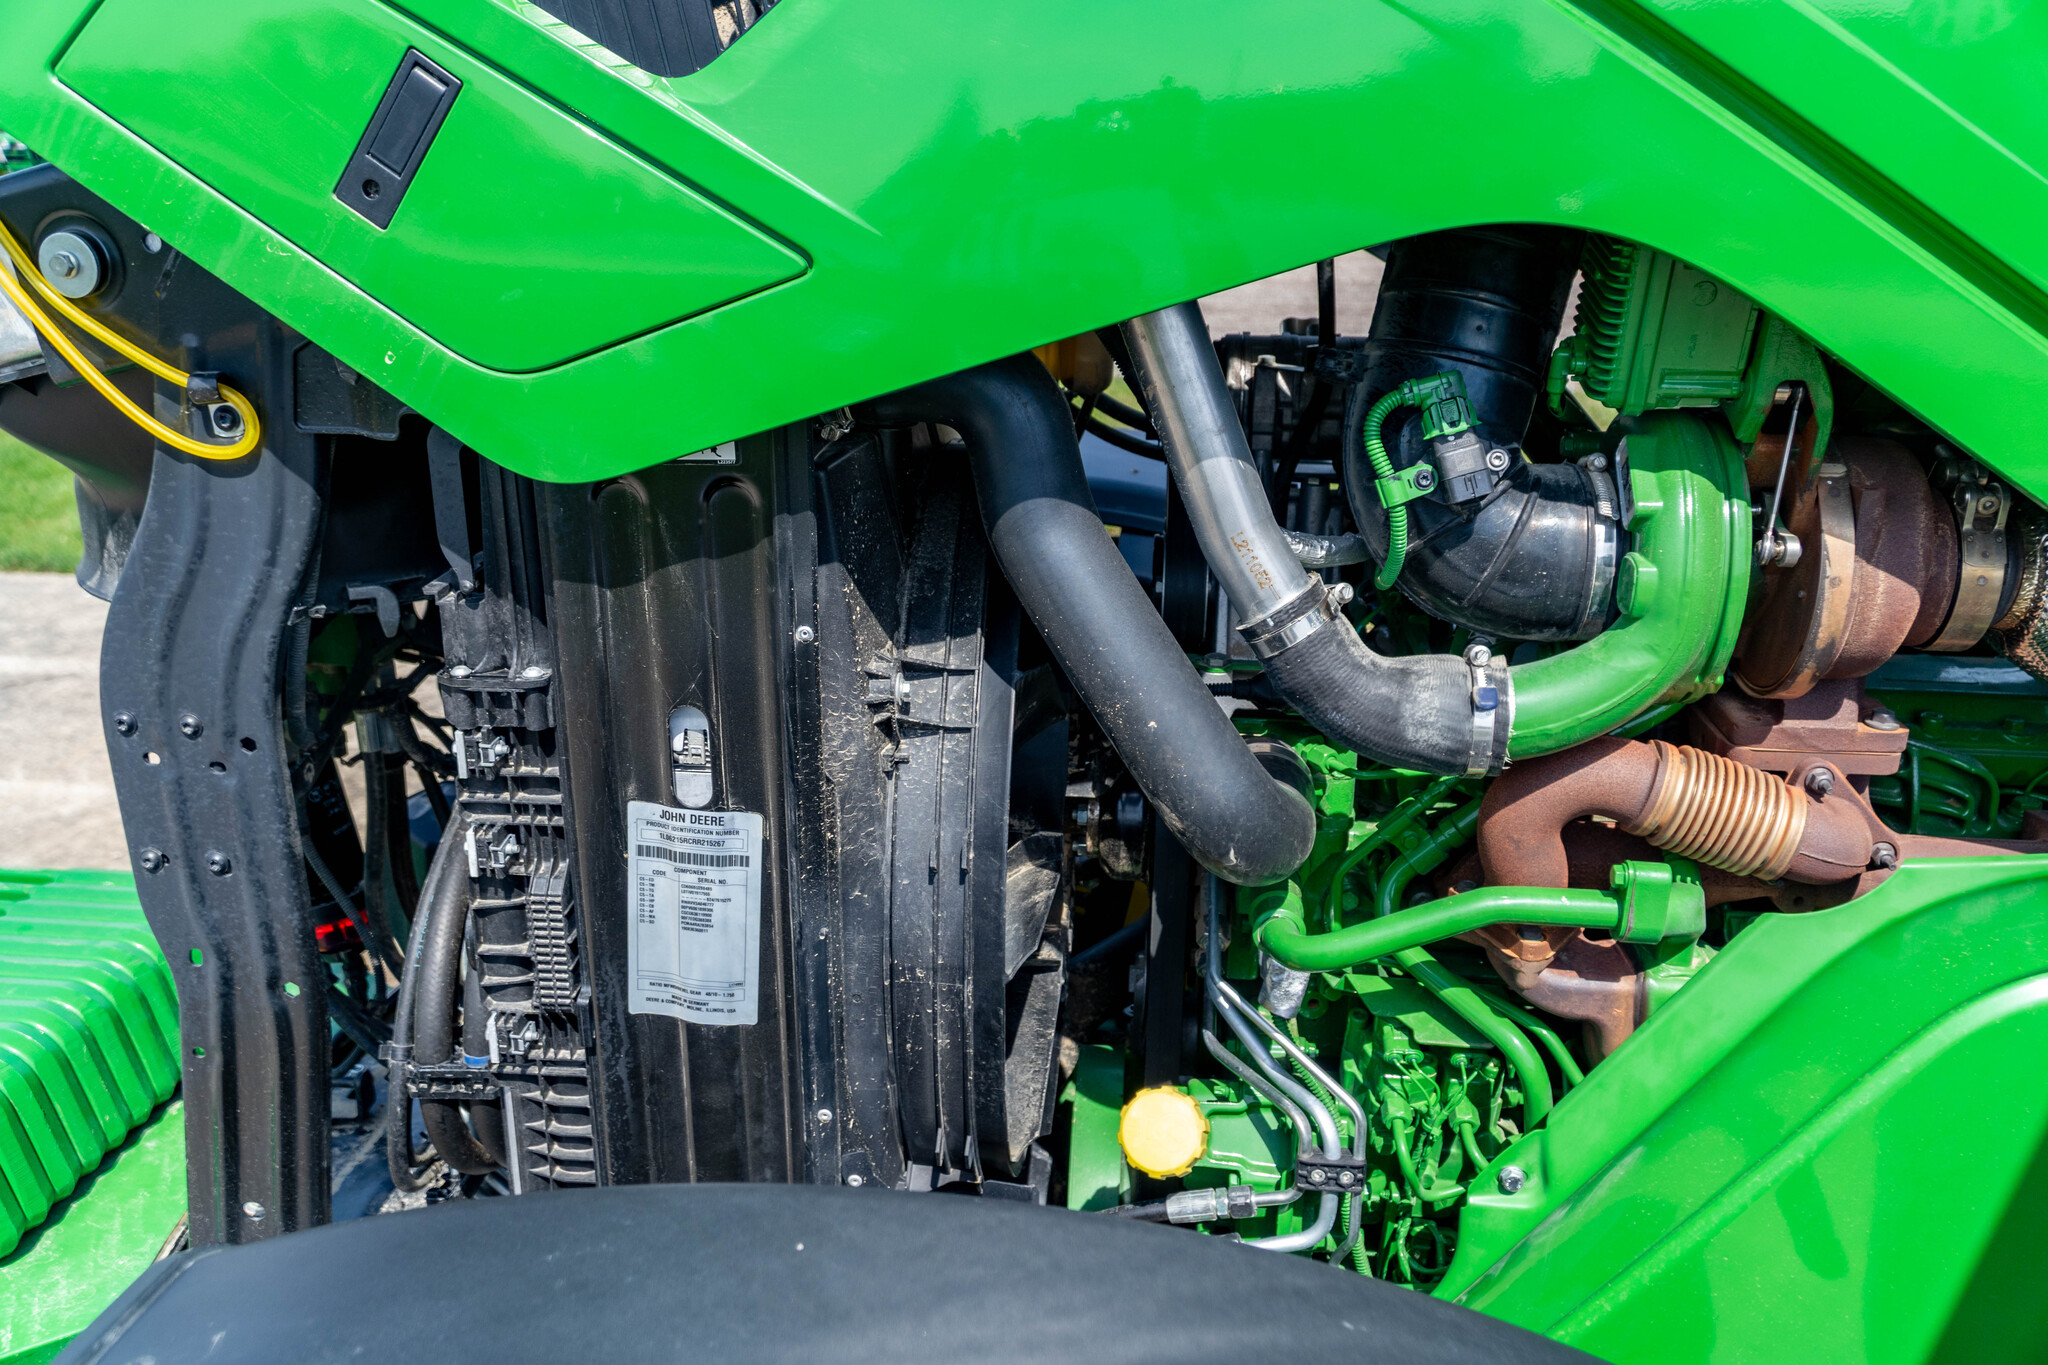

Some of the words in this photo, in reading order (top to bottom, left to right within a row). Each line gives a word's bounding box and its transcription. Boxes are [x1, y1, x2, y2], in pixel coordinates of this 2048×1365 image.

[660, 809, 686, 823] JOHN
[690, 814, 724, 826] DEERE
[646, 820, 670, 831] PRODUCT
[671, 826, 714, 836] IDENTIFICATION
[674, 867, 707, 876] COMPONENT
